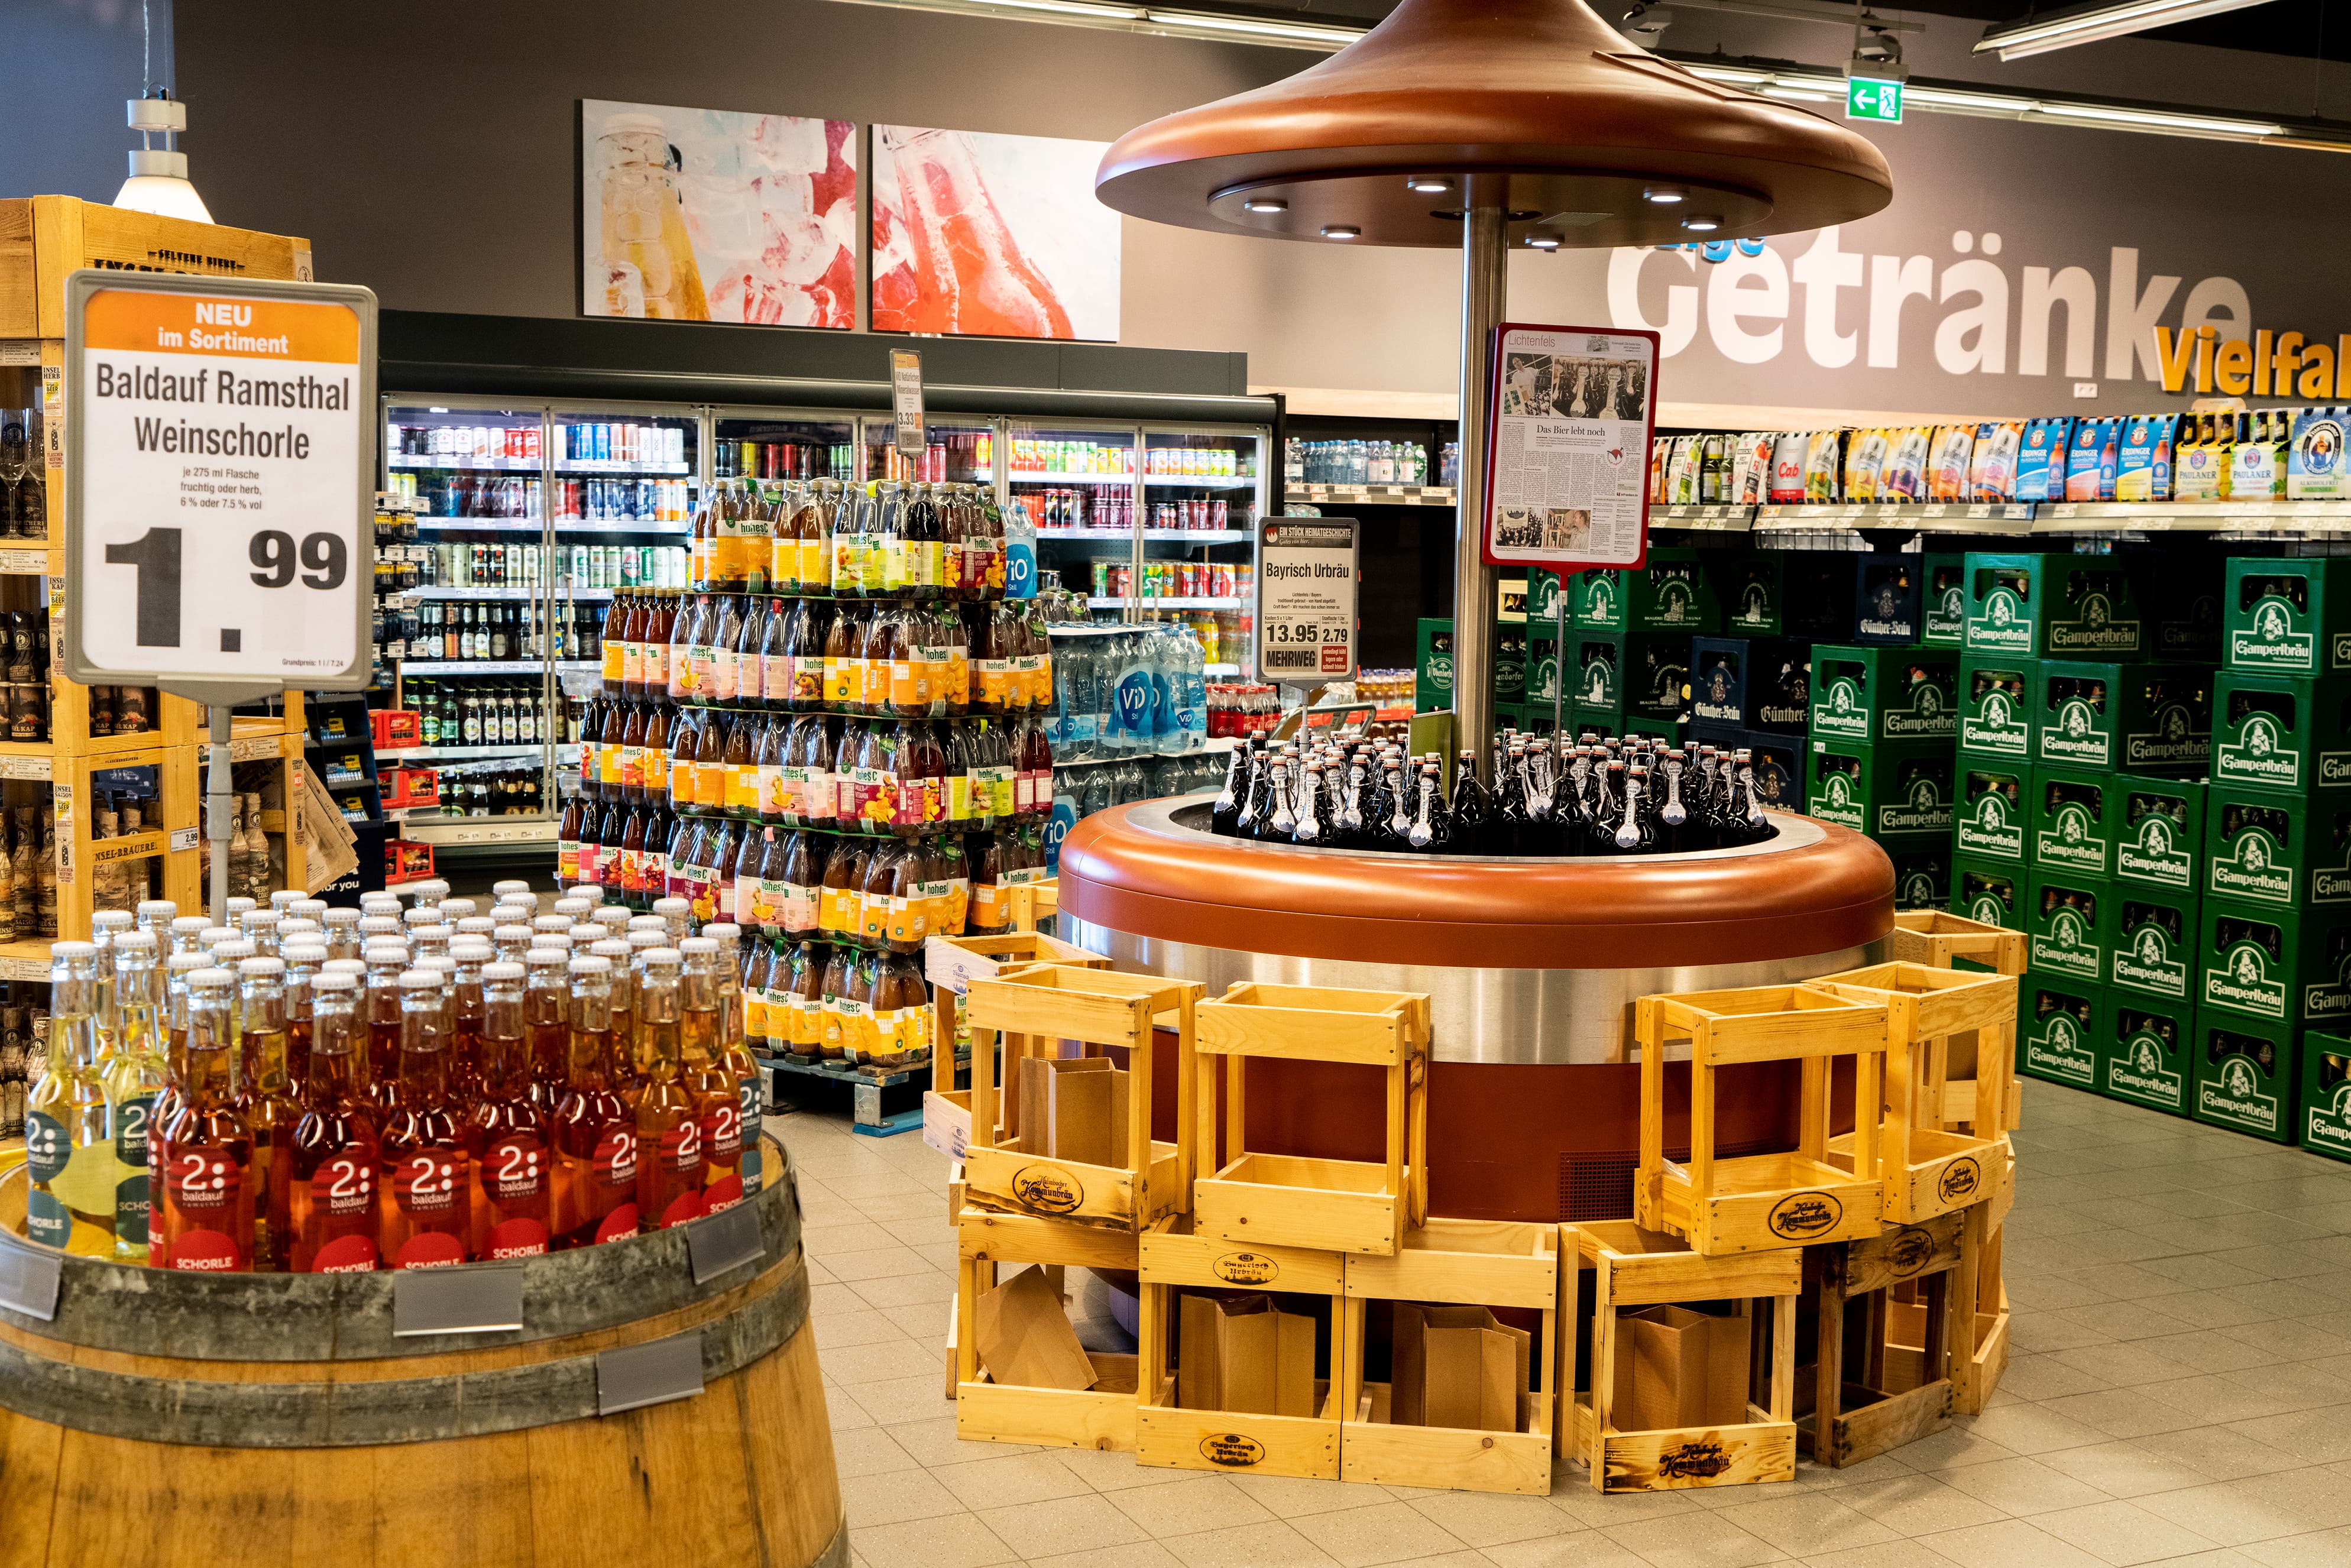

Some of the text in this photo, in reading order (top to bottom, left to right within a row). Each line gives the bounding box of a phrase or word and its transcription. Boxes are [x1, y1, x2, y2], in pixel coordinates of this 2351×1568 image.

[158, 248, 202, 265] SELTENE
[206, 255, 237, 270] BIERE
[1607, 225, 2251, 383] Getränke
[196, 302, 252, 327] NEU
[158, 327, 289, 354] im Sortiment
[1508, 333, 1556, 348] Lichtenfels
[96, 363, 349, 412] Baldauf Ramsthal
[898, 412, 914, 426] 3.33
[1537, 425, 1605, 436] Das Bier lebt noch
[134, 416, 310, 459] Weinschorle
[2021, 449, 2047, 458] ERDINGER
[2071, 449, 2098, 458] ERDINGER
[2122, 448, 2151, 456] ERDINGER
[183, 466, 260, 479] je 275 ml Flasche
[1778, 461, 1799, 479] Cab
[2179, 471, 2217, 480] PAULANER
[2233, 470, 2271, 479] PAULANER
[180, 481, 261, 496] fruchtig oder herb,
[180, 497, 261, 509] 6 % oder 7.5 % vol
[741, 523, 763, 533] hohes
[1279, 525, 1351, 537] EIN STÜCK HEIMATGESCHICHTE
[849, 534, 867, 545] hohes
[974, 537, 988, 549] hohes
[1267, 562, 1349, 580] Bayrisch Urbräu
[1267, 624, 1318, 642] 13.95
[1860, 618, 1910, 636] Günther-Bräu
[1323, 629, 1348, 642] 2.79
[282, 658, 316, 666] Grundpreis:
[986, 661, 1003, 669] hohes
[1019, 657, 1034, 669] hohes
[1267, 650, 1316, 668] MEHRWEG
[1695, 701, 1740, 720] Günther-Bräu
[1178, 714, 1193, 723] ViO
[855, 770, 877, 781] hohes C
[54, 785, 72, 793] INSEL
[186, 832, 198, 843] 2.99
[561, 841, 578, 850] hohes
[339, 881, 360, 892] you
[927, 883, 947, 895] hohes
[840, 999, 855, 1011] hohes
[499, 1180, 537, 1192] baldauf
[182, 1191, 224, 1203] baldauf
[331, 1196, 369, 1209] baldauf
[412, 1192, 452, 1204] baldauf
[493, 1243, 545, 1259] SCHORLE
[177, 1256, 233, 1271] SCHORLE
